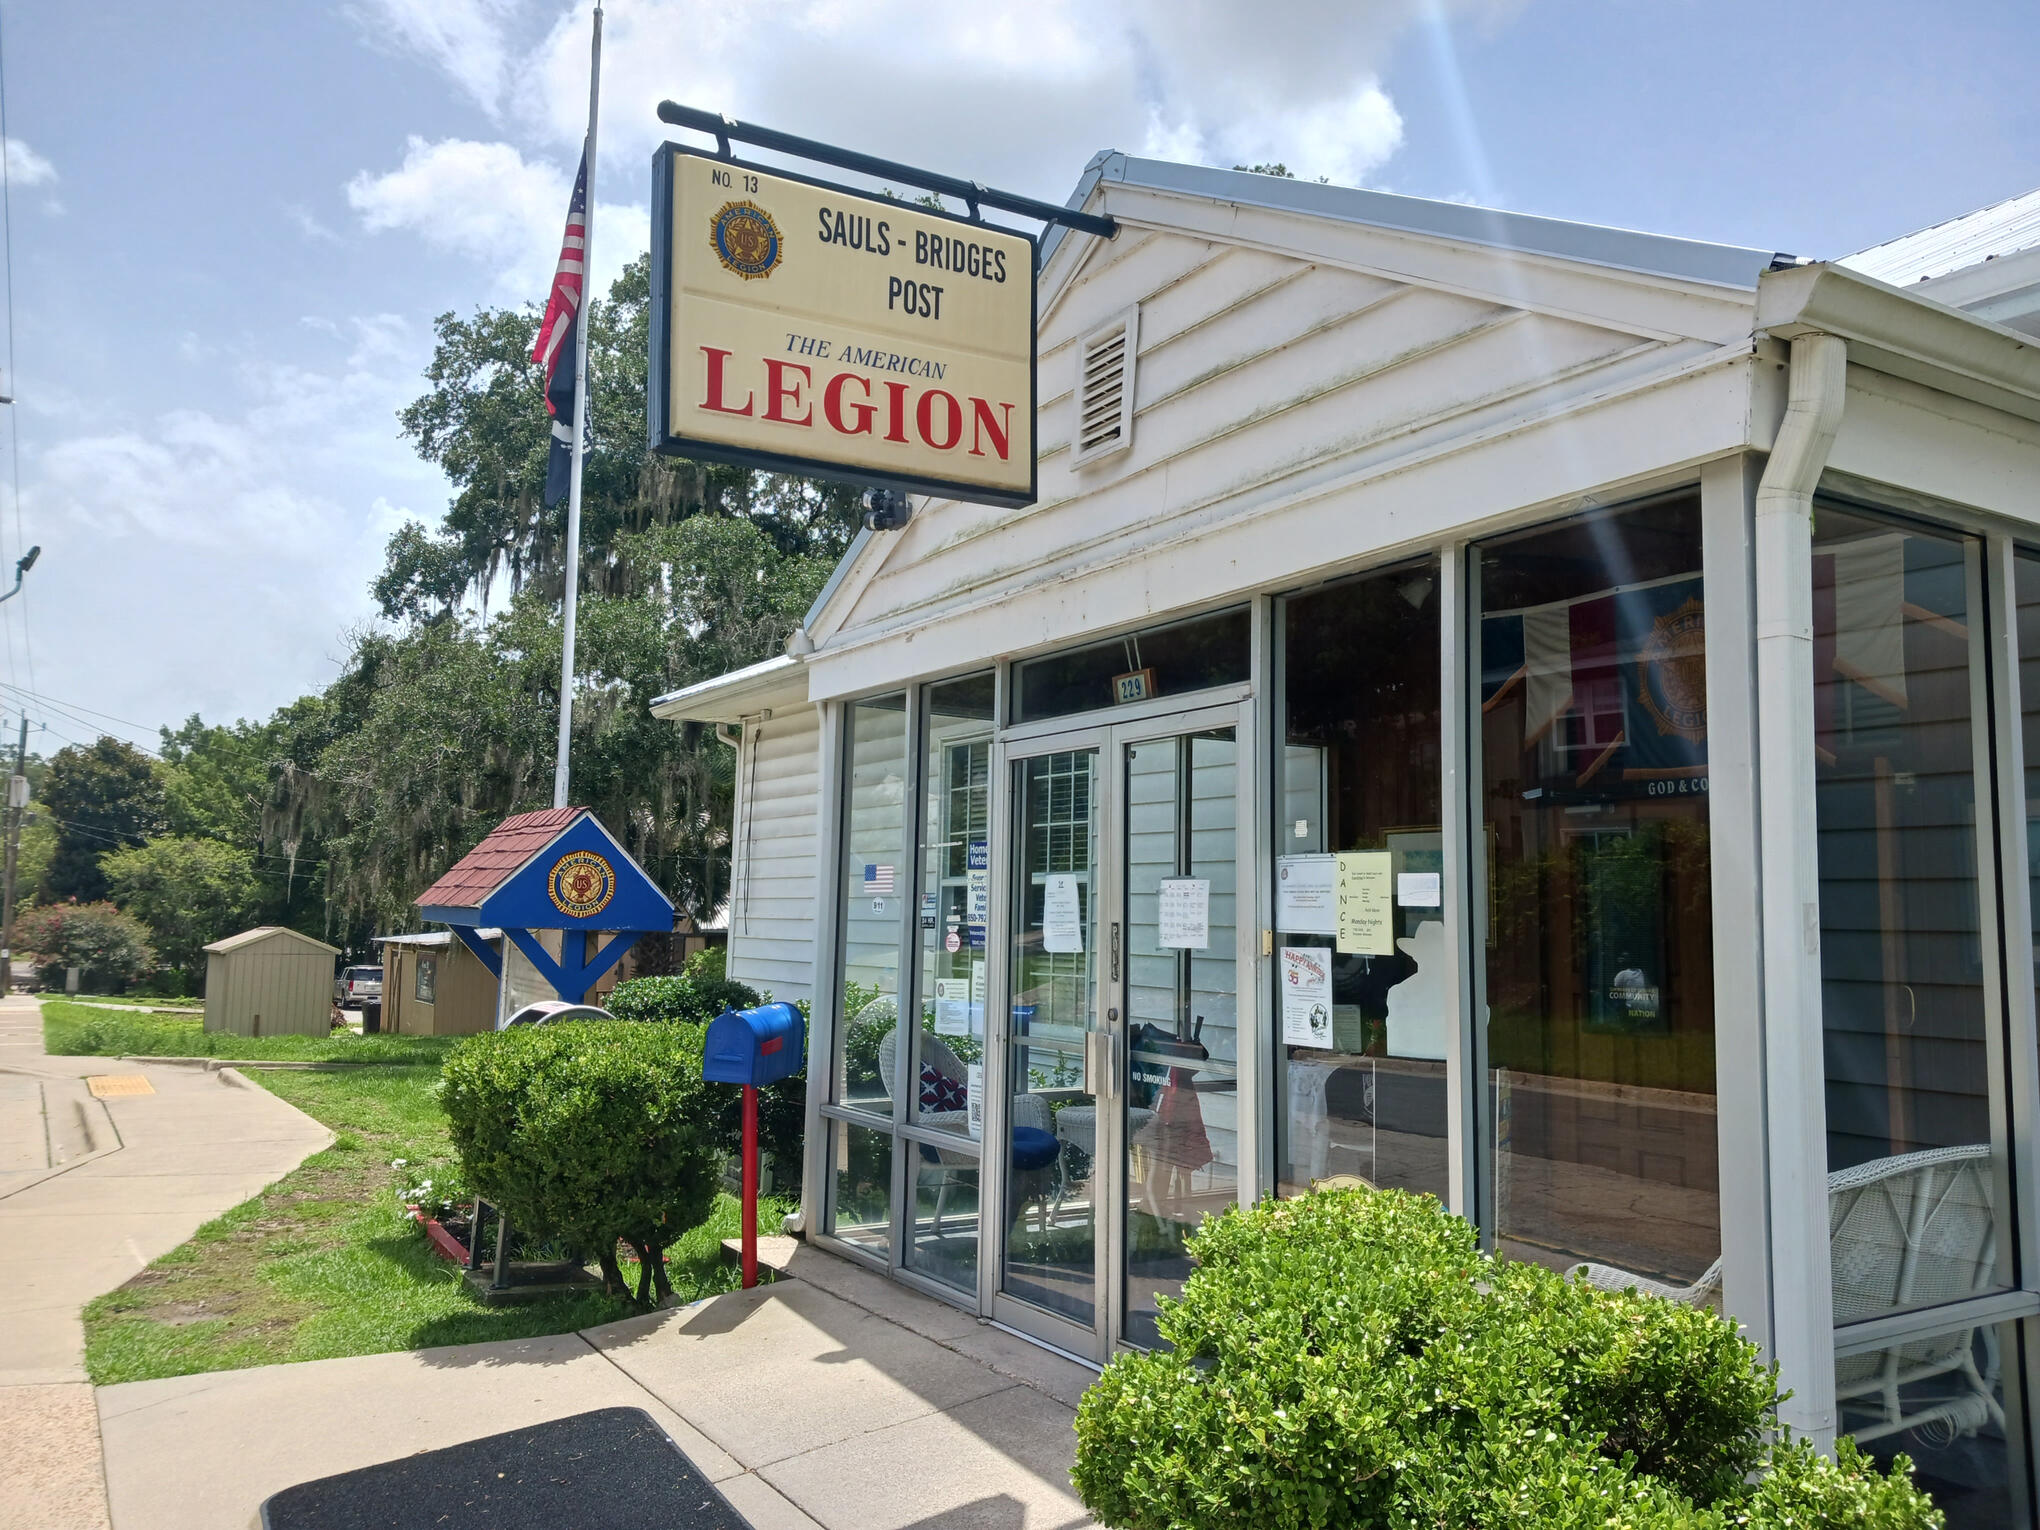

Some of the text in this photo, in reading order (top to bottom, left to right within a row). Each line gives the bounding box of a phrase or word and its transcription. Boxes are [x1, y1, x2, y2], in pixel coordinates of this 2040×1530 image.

[711, 169, 758, 193] NO. 13
[721, 208, 775, 238] AMERICAN
[818, 207, 890, 256] SAULS
[915, 230, 1006, 283] BRIDGES
[727, 256, 765, 273] LEGION
[889, 276, 943, 320] POST
[786, 333, 947, 380] THE AMERICAN
[699, 346, 1015, 460] LEGION
[1121, 678, 1141, 699] 229
[1648, 781, 1675, 795] GOD
[1678, 779, 1688, 793] &
[558, 858, 607, 878] AMERICAN
[576, 879, 588, 889] US
[562, 899, 599, 911] LEGION
[1288, 970, 1299, 985] 35
[1132, 1071, 1171, 1086] NO SMOKING
